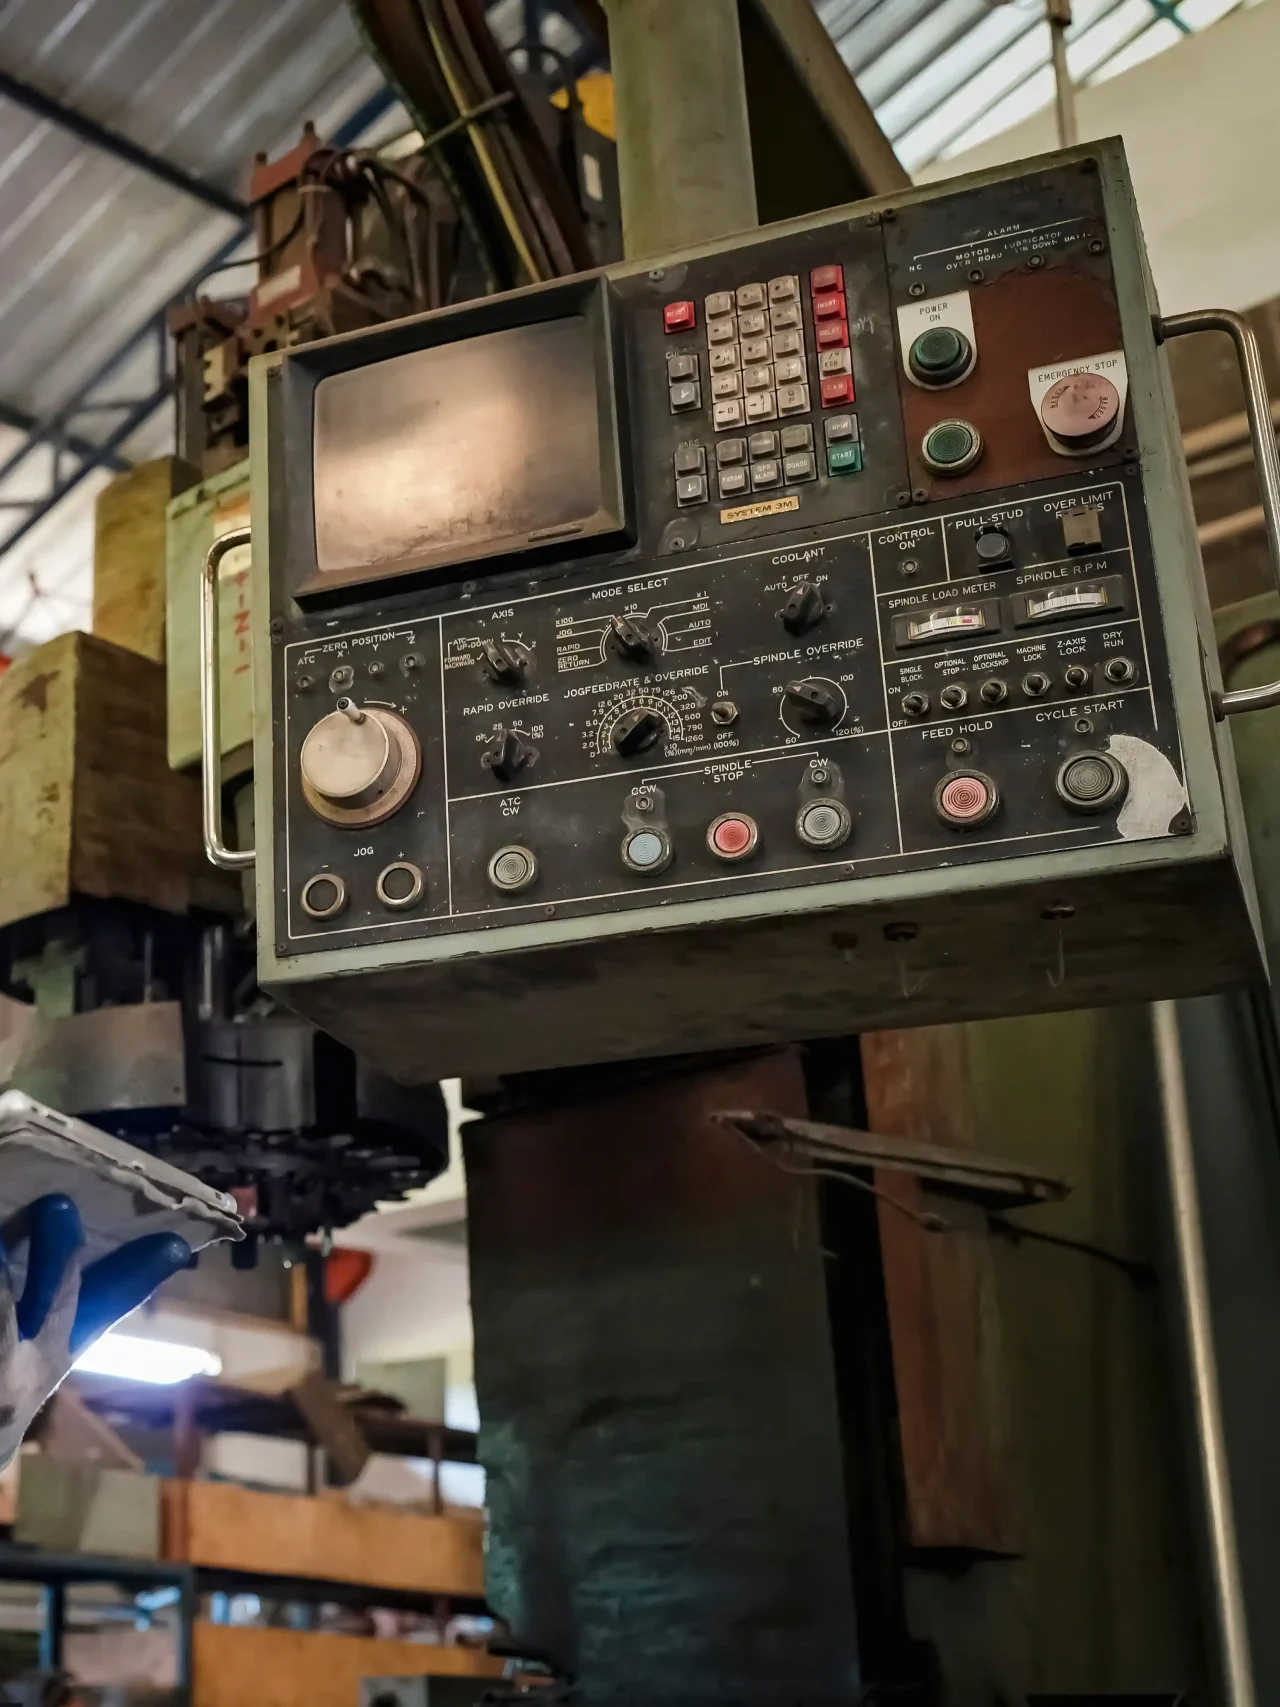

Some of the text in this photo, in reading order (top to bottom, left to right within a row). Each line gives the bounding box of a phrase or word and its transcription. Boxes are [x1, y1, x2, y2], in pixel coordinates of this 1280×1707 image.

[988, 224, 1020, 237] ALARM
[956, 247, 989, 260] MOTOR
[909, 264, 922, 272] NC
[818, 300, 836, 308] INSRT
[920, 303, 948, 315] POWER
[930, 314, 940, 322] ON
[1038, 360, 1117, 382] EMERGENCY STOP
[832, 451, 852, 460] START
[1044, 499, 1076, 512] OVER
[1081, 491, 1113, 505] LIMIT
[727, 501, 792, 519] SYSTEM 3M
[956, 509, 1023, 529] PULL-STUD
[879, 527, 934, 544] CONTROL
[899, 540, 915, 550] ON
[772, 547, 825, 565] COOLANT
[793, 573, 809, 582] OFF
[816, 574, 828, 582] ON
[1016, 568, 1068, 585] SPINDLE
[591, 578, 668, 600] MODE SELECT
[764, 582, 787, 592] AUTO
[888, 581, 996, 609] SPINDLE LOAD METER
[693, 603, 708, 611] MDI
[492, 609, 514, 620] AXIS
[689, 619, 711, 628] AUTO
[409, 636, 415, 644] Z
[1103, 630, 1122, 640] DRY
[323, 632, 394, 652] ZERO POSITION
[694, 637, 711, 645] EDIT
[1057, 637, 1086, 648] Z-AXIS
[1104, 639, 1124, 648] RUN
[557, 643, 580, 653] RAPID
[753, 638, 864, 665] SPINDLE OVERRIDE
[1016, 644, 1046, 655] MACHINE
[1060, 645, 1086, 656] LOCK
[298, 656, 315, 665] ATC
[444, 654, 470, 663] FORWARD
[558, 655, 578, 663] ZERO
[974, 651, 1006, 662] OPTIONAL
[1023, 654, 1041, 662] LOCK
[445, 659, 474, 670] BACKWARD
[558, 659, 589, 670] RETURN
[935, 658, 966, 669] OPTIONAL
[973, 659, 1009, 671] BLOCKSKIP
[900, 665, 922, 675] SINGLE
[942, 668, 959, 676] STOP
[564, 665, 708, 699] JOGFEEDRATE & OVERRIDE
[841, 674, 854, 682] 100
[901, 674, 923, 683] BLOCK
[626, 688, 636, 696] 32
[662, 688, 675, 696] 126
[464, 693, 549, 716] RAPID OVERRIDE
[680, 702, 696, 711] 320
[1036, 700, 1124, 722] CYCLE START
[685, 713, 700, 721] 500
[922, 721, 993, 740] FEED HOLD
[685, 734, 703, 742] 1260
[717, 732, 733, 740] OFF
[582, 741, 594, 749] 2.0
[714, 739, 739, 750] (100%)
[704, 759, 752, 775] SPINDLE
[810, 758, 828, 768] CW
[714, 771, 744, 783] STOP
[632, 785, 656, 795] CCW
[500, 797, 521, 807] ATC
[503, 807, 520, 816] CW
[354, 847, 374, 856] JOG
